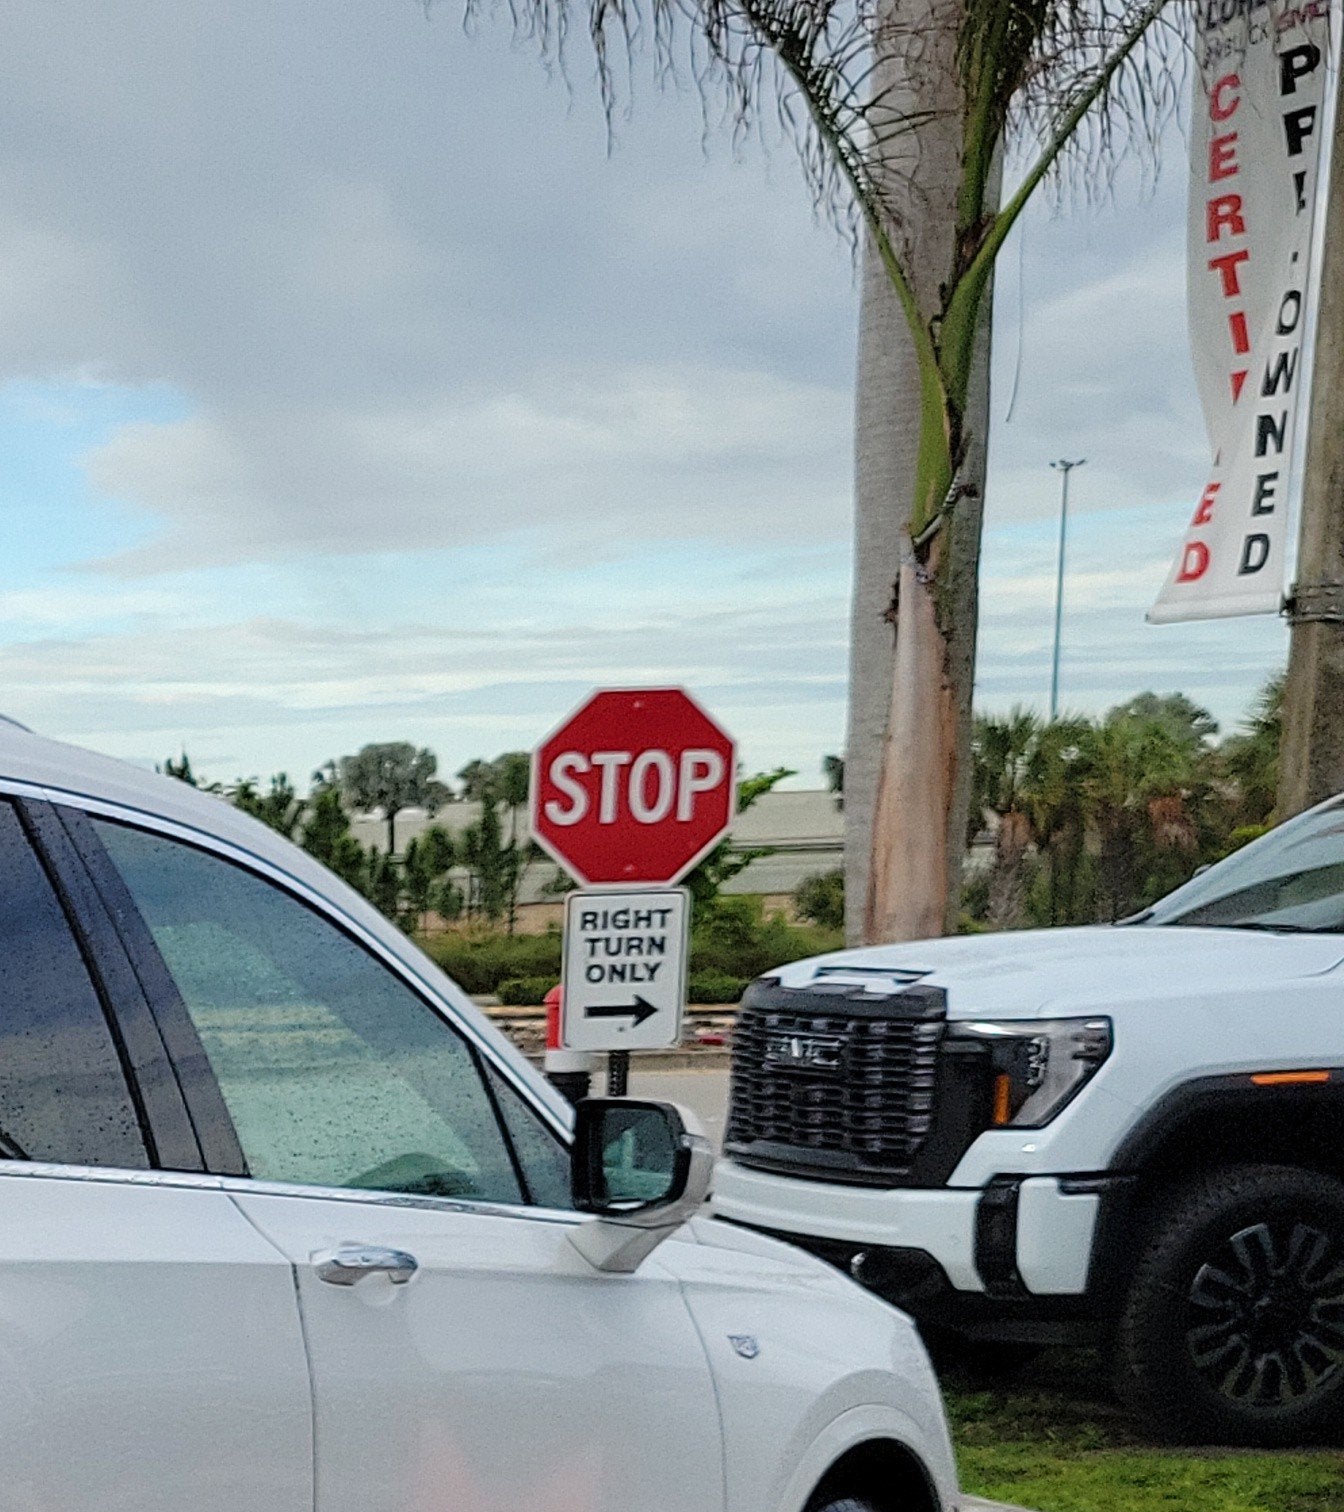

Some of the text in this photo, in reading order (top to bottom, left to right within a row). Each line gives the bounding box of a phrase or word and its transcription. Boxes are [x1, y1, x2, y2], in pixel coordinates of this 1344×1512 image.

[1175, 73, 1250, 583] CERTIED
[543, 748, 727, 826] STOP
[580, 908, 673, 931] RIGHT
[584, 936, 666, 957] TURN
[586, 961, 662, 984] ONLY
